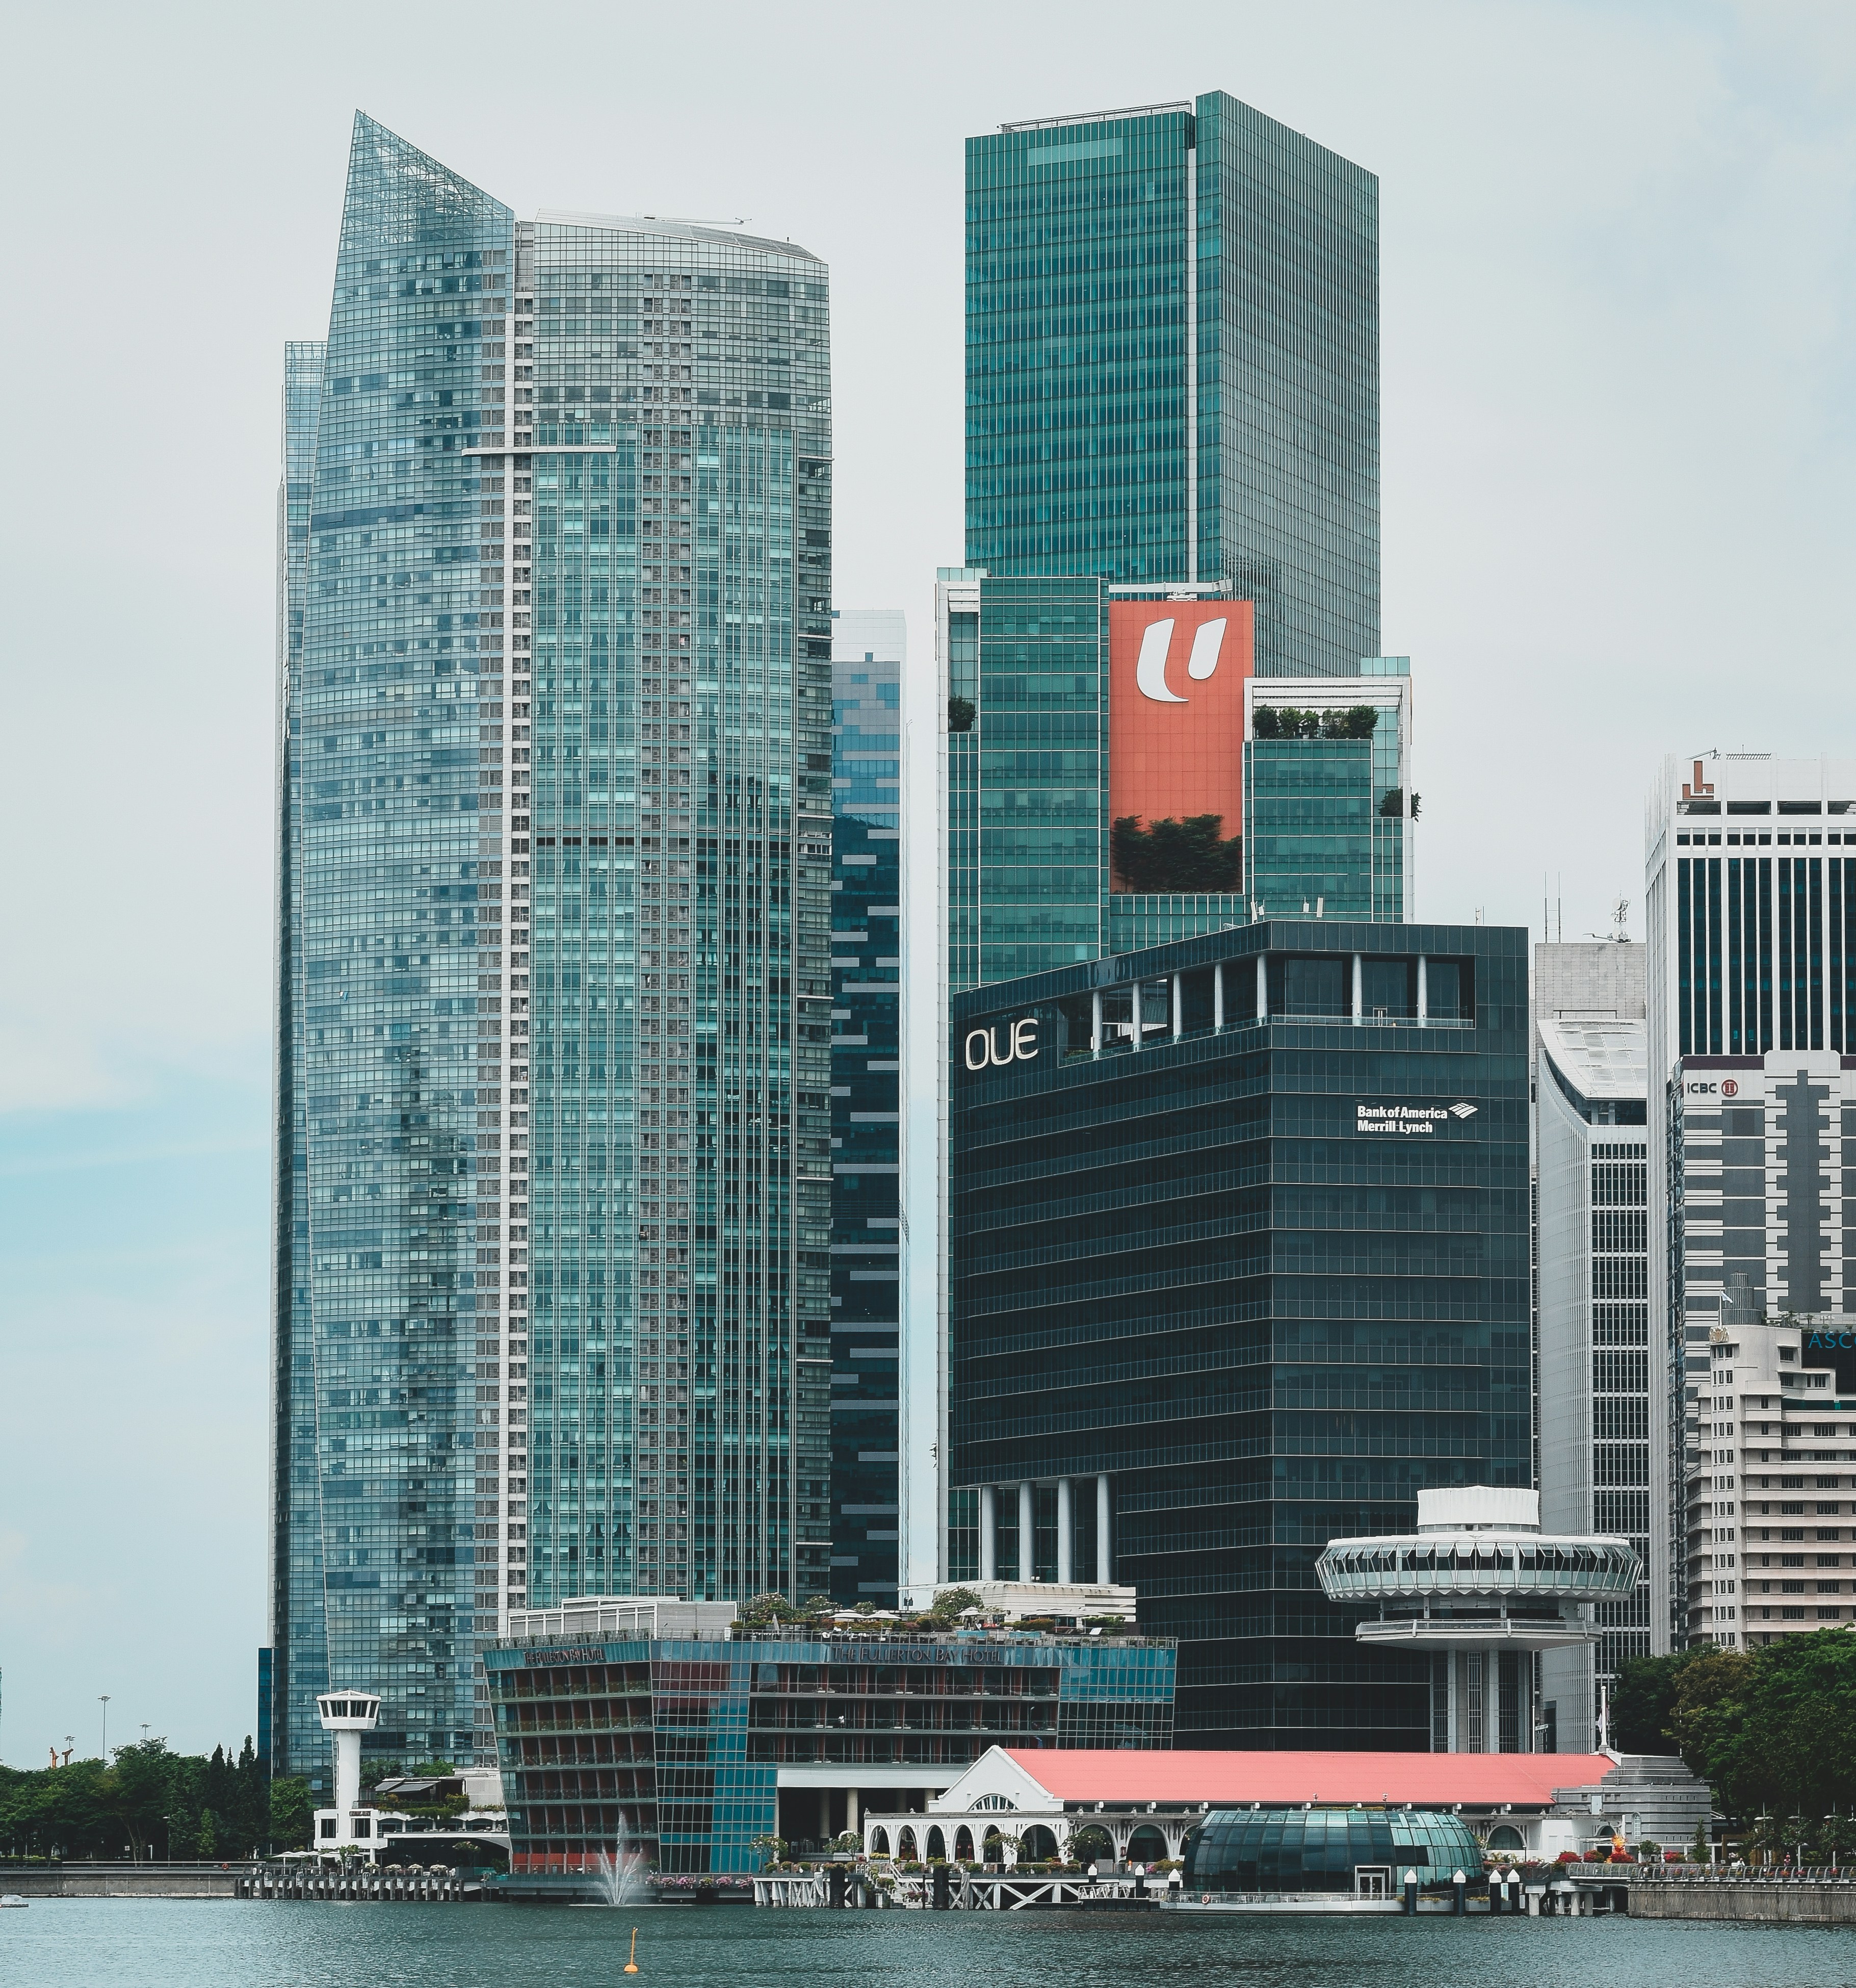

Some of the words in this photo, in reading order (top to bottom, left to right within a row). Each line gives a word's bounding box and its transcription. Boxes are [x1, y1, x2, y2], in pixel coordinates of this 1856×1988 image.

[965, 1018, 1039, 1070] OUE
[1687, 1082, 1717, 1094] ICBC
[1357, 1105, 1387, 1118] Bank
[1387, 1106, 1401, 1118] of
[1401, 1106, 1448, 1119] America
[1357, 1120, 1396, 1131] Merrill
[1399, 1121, 1433, 1134] Lynch
[1808, 1332, 1856, 1349] ASC
[522, 1651, 535, 1664] THE
[536, 1650, 569, 1663] FULLERTON
[569, 1649, 581, 1662] BAY
[582, 1648, 605, 1661] HOTEL
[832, 1646, 856, 1661] THE
[861, 1647, 931, 1662] FULLERTON
[935, 1648, 957, 1662] BAY
[960, 1648, 1003, 1663] HOTEL
